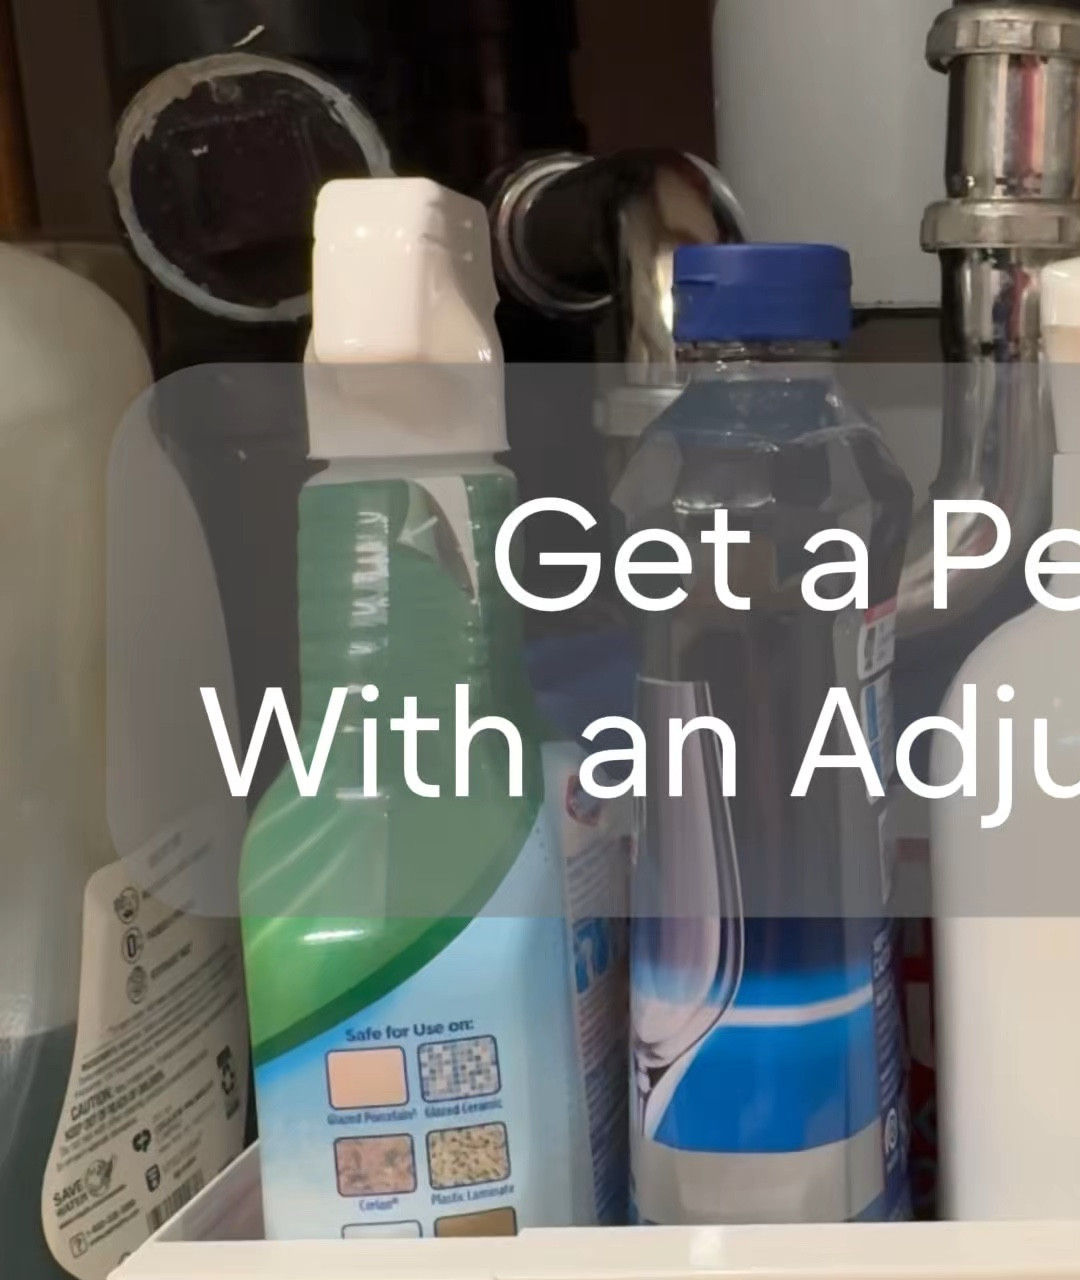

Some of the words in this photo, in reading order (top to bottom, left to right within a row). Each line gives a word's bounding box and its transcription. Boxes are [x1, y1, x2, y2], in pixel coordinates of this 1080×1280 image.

[345, 1025, 383, 1043] Safe
[386, 1024, 410, 1040] for
[413, 1020, 445, 1037] Use
[448, 1018, 475, 1032] on:
[327, 1111, 363, 1126] Glazed
[424, 1103, 461, 1119] Glazed
[53, 1178, 83, 1207] SAVE
[430, 1190, 465, 1206] Plastic
